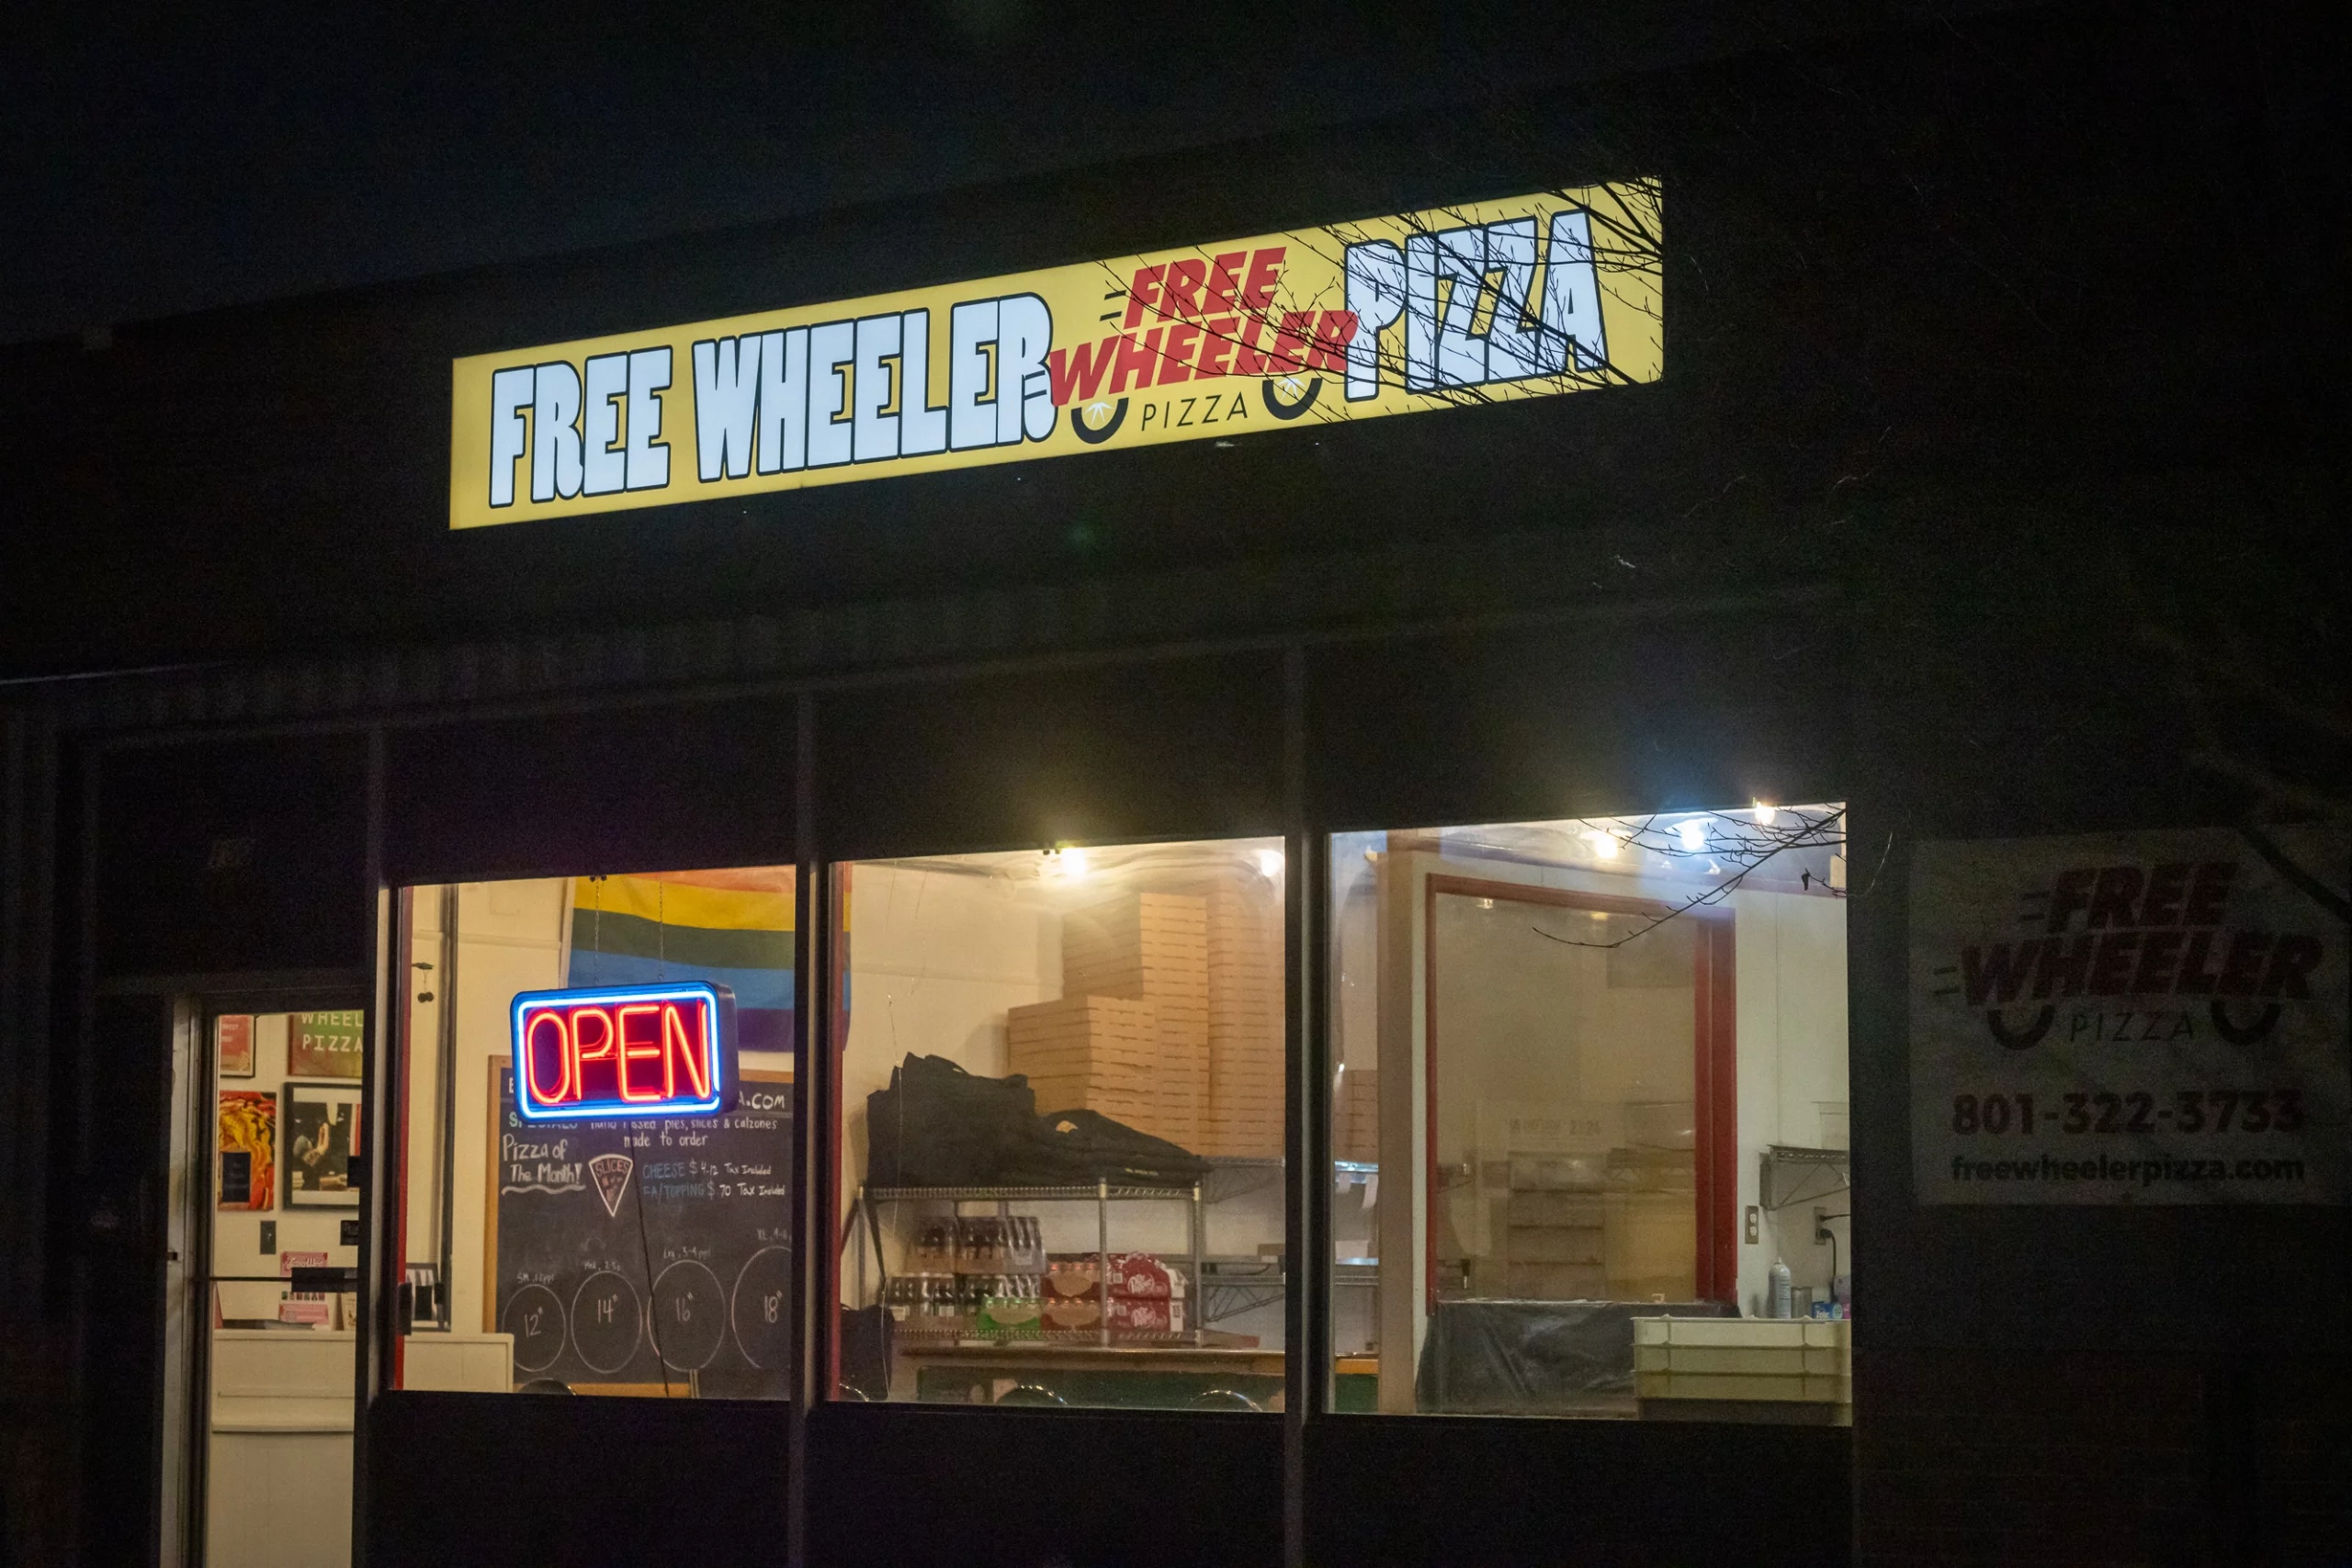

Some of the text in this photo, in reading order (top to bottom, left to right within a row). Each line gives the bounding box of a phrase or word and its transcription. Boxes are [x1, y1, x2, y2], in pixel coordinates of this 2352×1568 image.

[1124, 246, 1287, 331] FREE
[489, 210, 1610, 509] FREE WHEELER PIZZA
[1049, 310, 1360, 408] WHEELER
[1141, 392, 1250, 432] PIZZA
[2046, 860, 2238, 934] FREE
[1960, 930, 2324, 1007] WHEELER
[301, 1033, 363, 1053] PIZZA
[2070, 1011, 2193, 1043] PIZZA
[526, 1004, 714, 1105] OPEN
[734, 1115, 778, 1131] calzones
[1951, 1089, 2304, 1135] 801-322-3733
[503, 1133, 568, 1162] Pizza of
[660, 1130, 673, 1147] to
[679, 1131, 708, 1147] order
[510, 1163, 533, 1183] The
[594, 1158, 630, 1179] SLICES
[642, 1161, 685, 1180] CHEESE
[1951, 1153, 2305, 1187] freewheelerpizza.com
